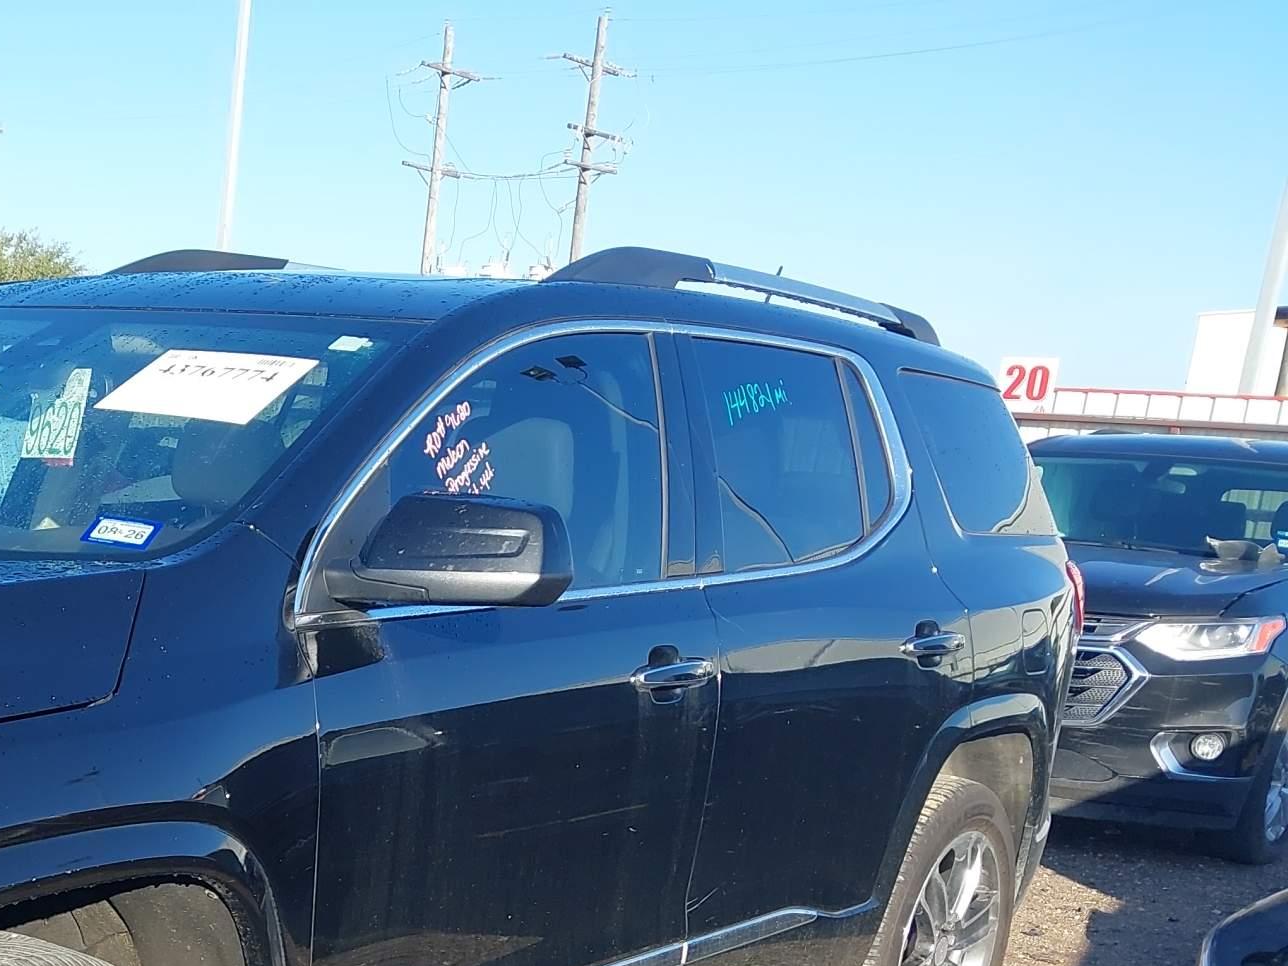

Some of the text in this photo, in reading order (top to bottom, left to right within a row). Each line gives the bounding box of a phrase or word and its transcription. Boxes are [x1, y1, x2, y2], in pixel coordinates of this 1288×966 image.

[159, 363, 280, 383] 43767774
[1003, 365, 1050, 401] 20
[26, 401, 81, 455] 9620
